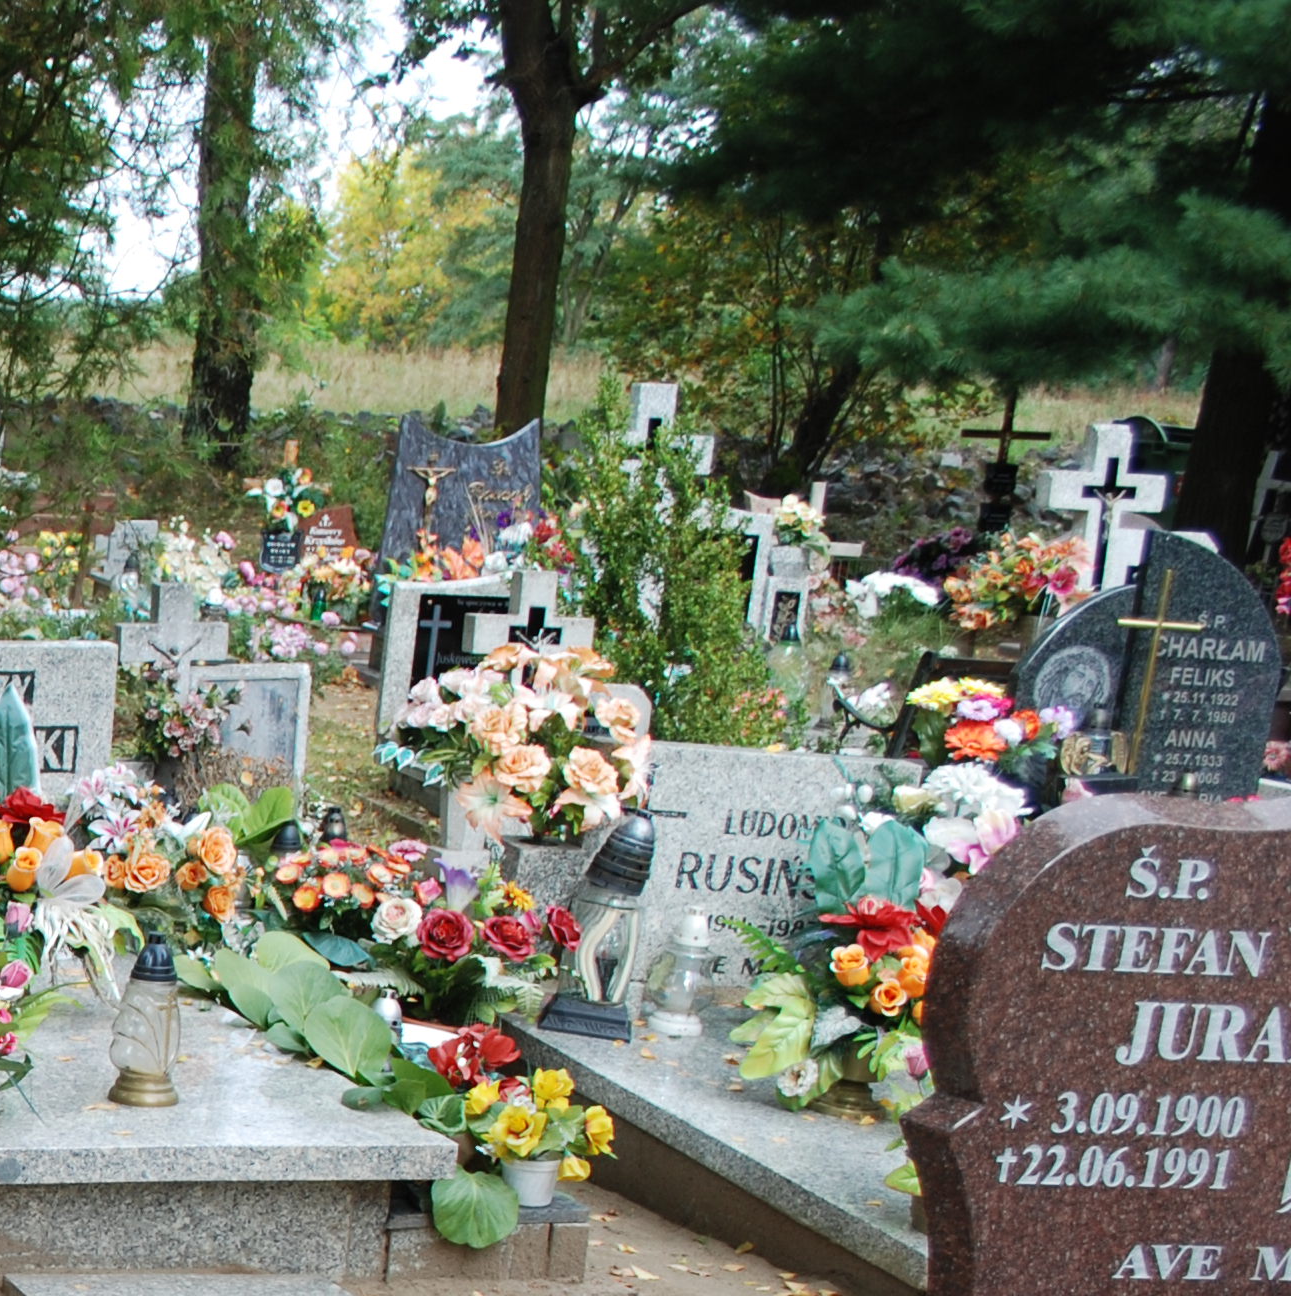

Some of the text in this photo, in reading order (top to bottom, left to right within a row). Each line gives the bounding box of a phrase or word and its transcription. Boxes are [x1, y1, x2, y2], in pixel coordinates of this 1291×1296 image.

[1155, 637, 1267, 663] CHARŁAM
[1170, 667, 1236, 688] FELIKS
[1164, 729, 1217, 750] ANNA
[674, 851, 818, 900] RUSIŃS
[1040, 922, 1272, 978] STEFAN
[1114, 1001, 1291, 1066] JURA
[1050, 1091, 1247, 1139] 3.09.1900
[1111, 1243, 1224, 1282] AVE
